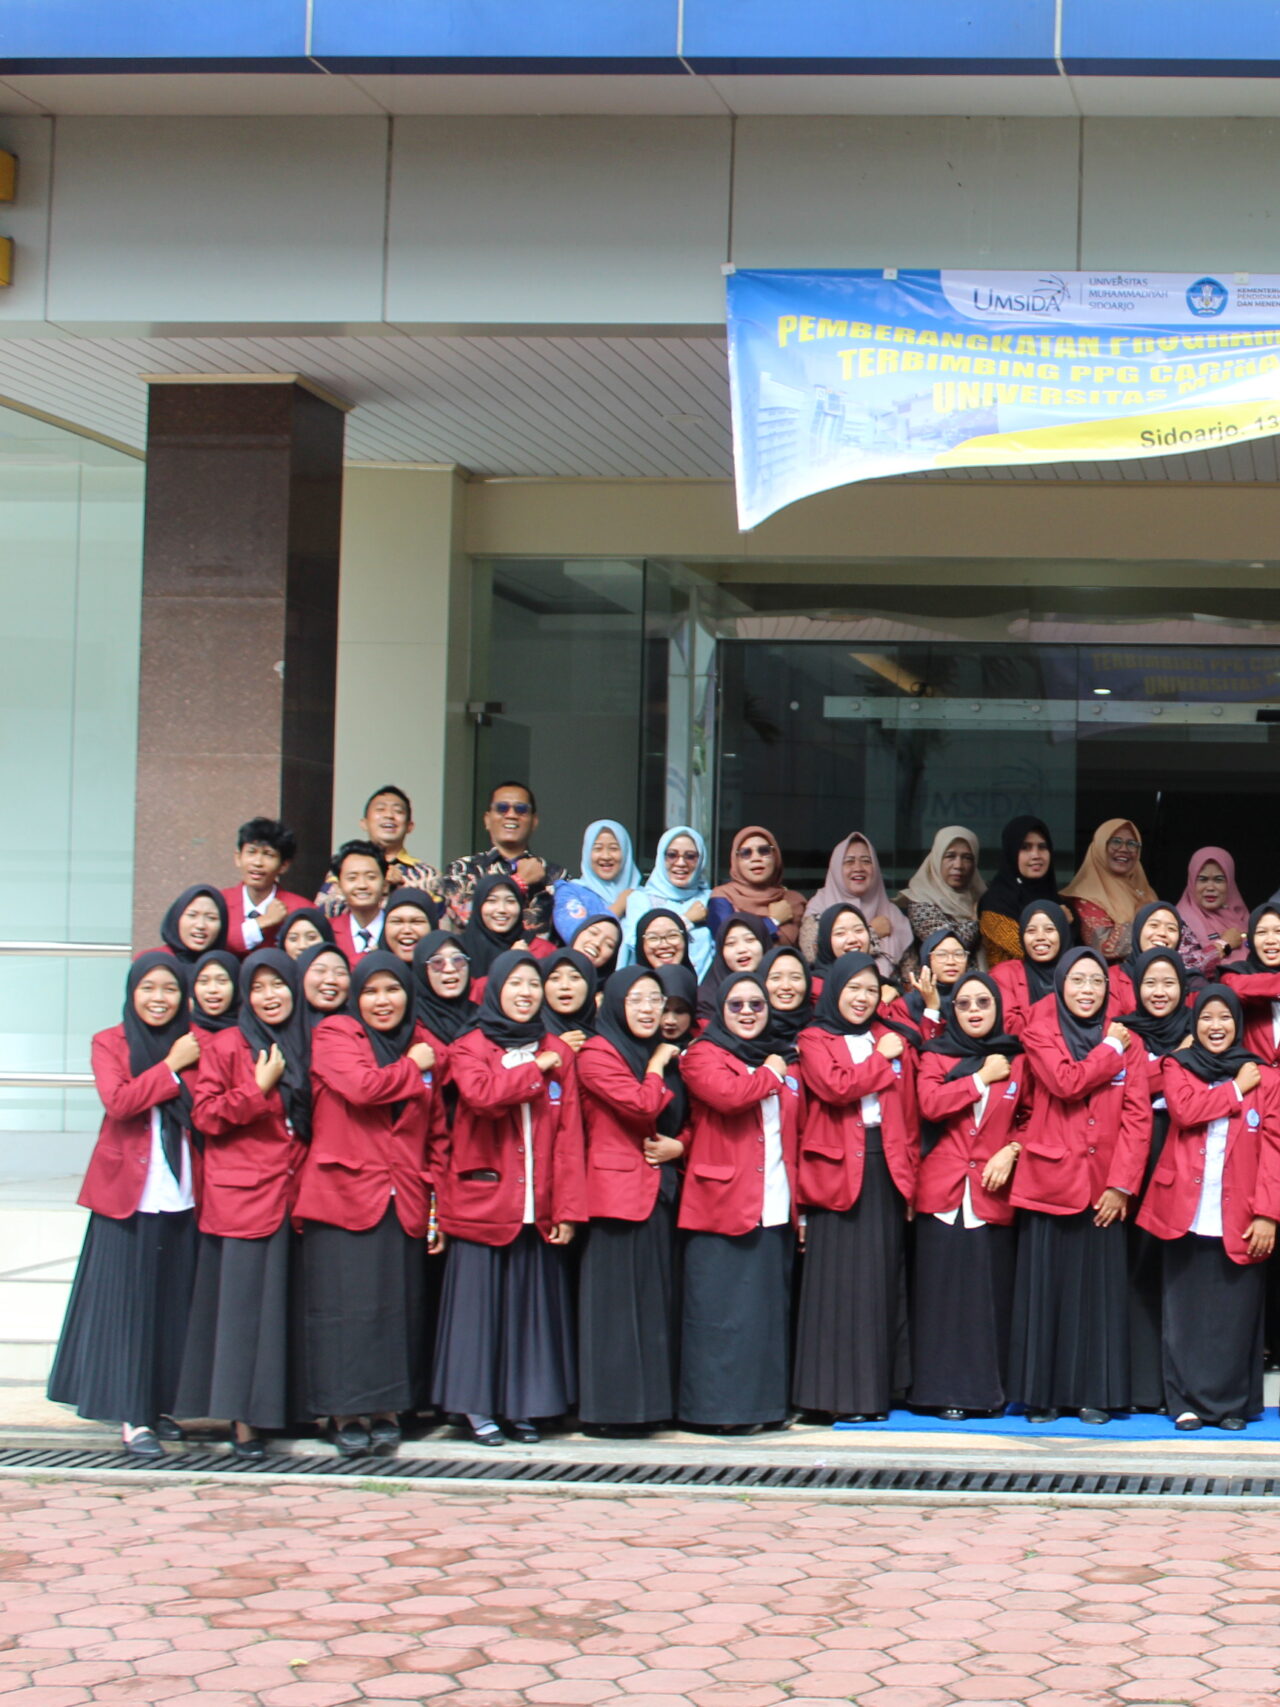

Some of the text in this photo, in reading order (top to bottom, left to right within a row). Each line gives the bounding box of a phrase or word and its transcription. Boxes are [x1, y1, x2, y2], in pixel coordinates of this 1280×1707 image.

[1088, 277, 1148, 287] UNIVERSITAS
[972, 287, 1061, 312] UMSIDA
[1088, 289, 1168, 299] MUHAMMADIYAH
[1088, 302, 1135, 310] SIDOARJO
[778, 314, 1099, 358] PEMBERANGKATAN
[837, 348, 1060, 381] TERBIMBING
[1071, 365, 1140, 383] PPG
[933, 381, 1168, 414] UNIVERSITAS
[1254, 415, 1279, 431] 13
